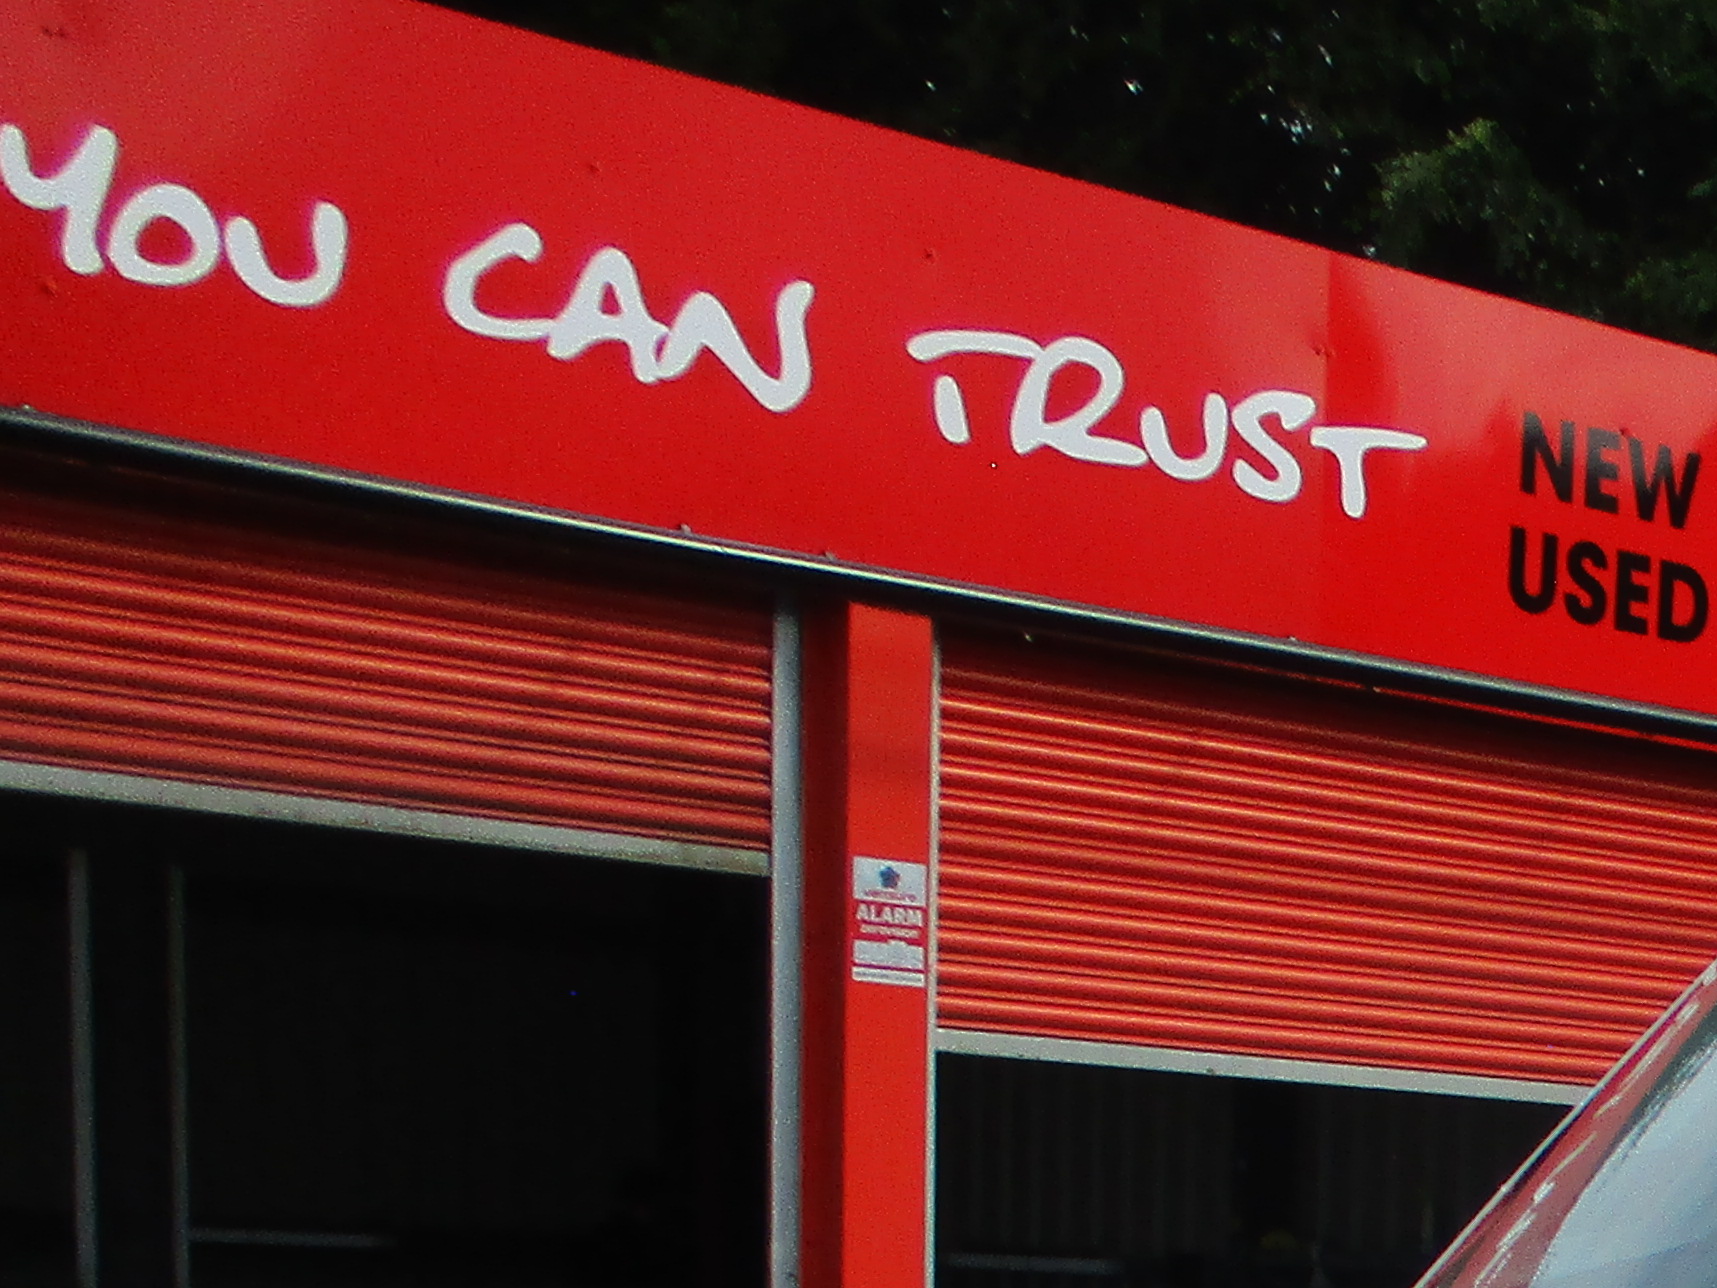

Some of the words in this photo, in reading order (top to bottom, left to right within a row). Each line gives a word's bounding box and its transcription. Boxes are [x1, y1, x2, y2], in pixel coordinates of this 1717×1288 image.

[0, 122, 349, 309] YOU
[444, 222, 815, 413] CAN
[906, 328, 1428, 518] TRUST
[1518, 408, 1702, 530] NEW
[1507, 524, 1710, 643] USED
[855, 903, 923, 928] ALARM
